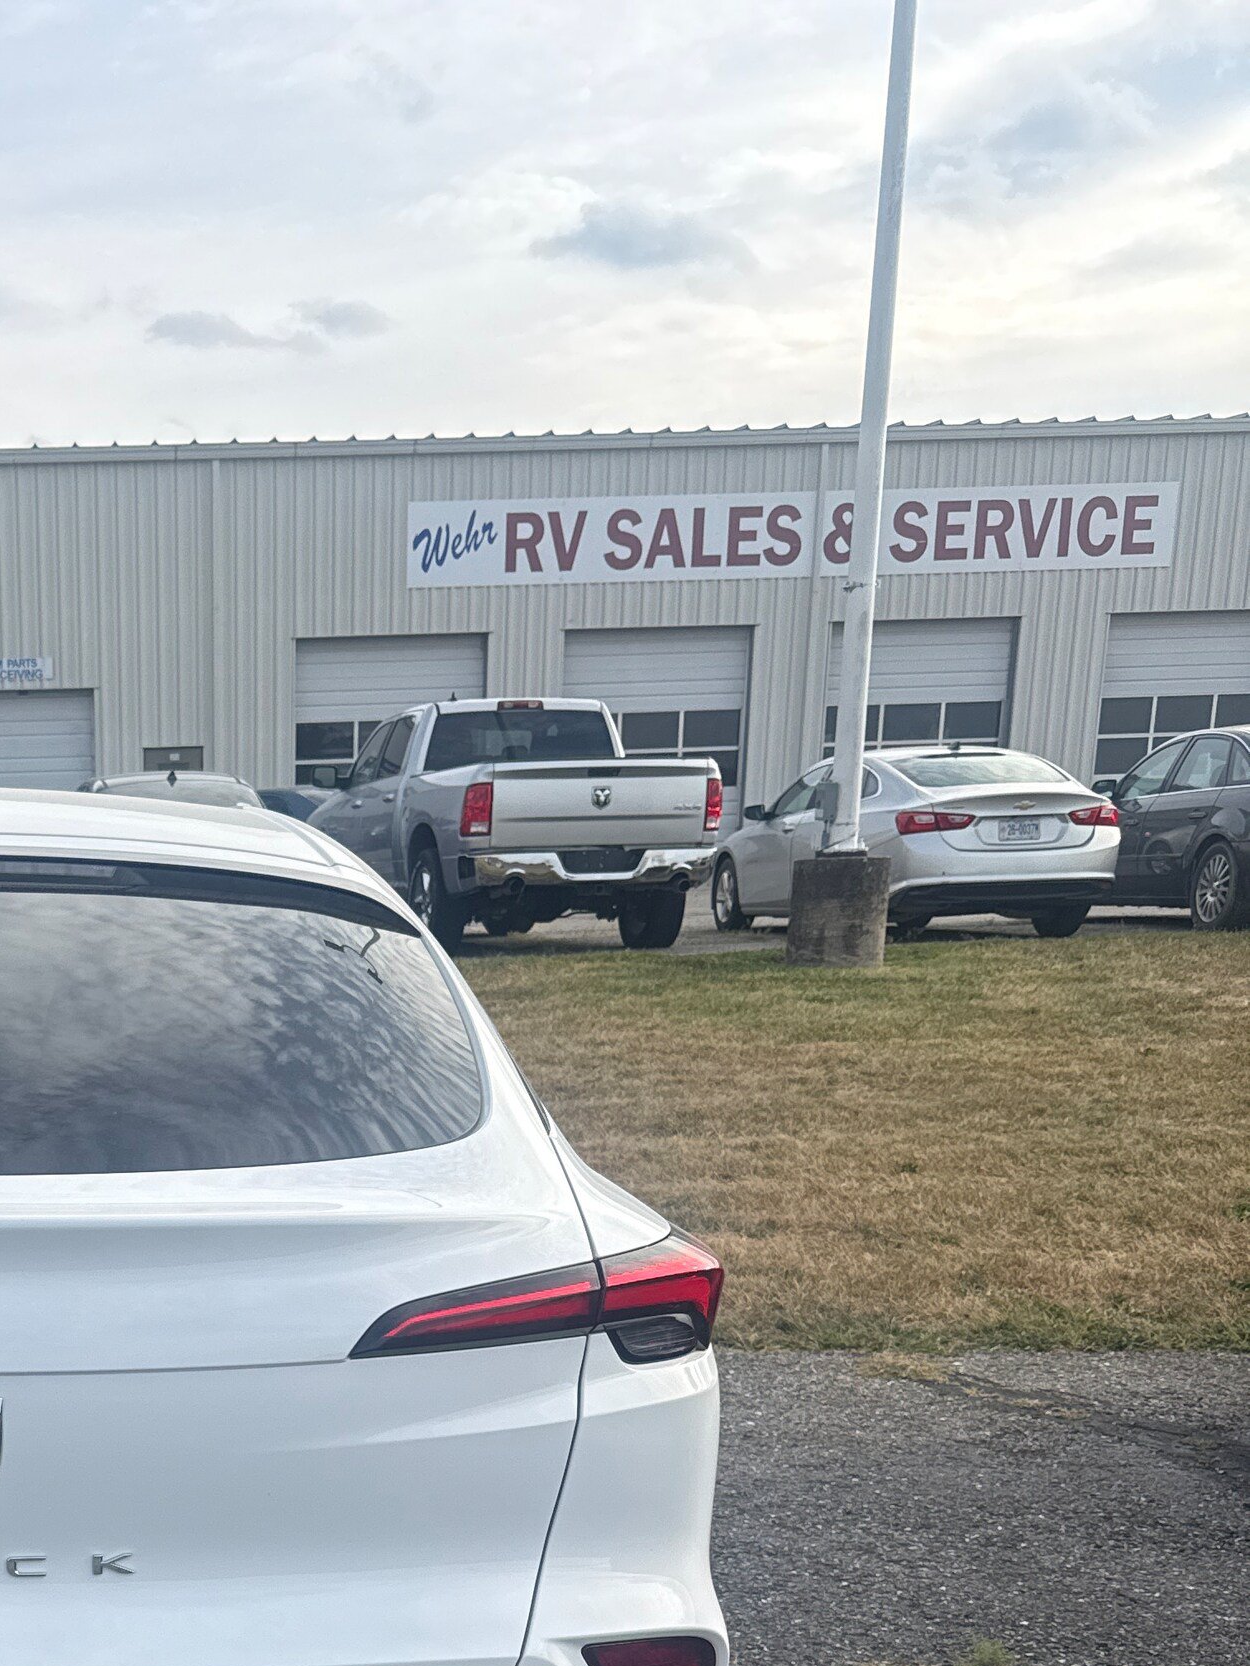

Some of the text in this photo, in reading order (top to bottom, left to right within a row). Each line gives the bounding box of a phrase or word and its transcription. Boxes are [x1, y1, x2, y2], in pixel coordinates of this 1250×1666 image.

[412, 509, 498, 573] Wehr
[504, 510, 588, 573] RV
[603, 504, 802, 571] SALES
[889, 495, 1160, 563] SERVICE
[7, 658, 38, 668] PARTS
